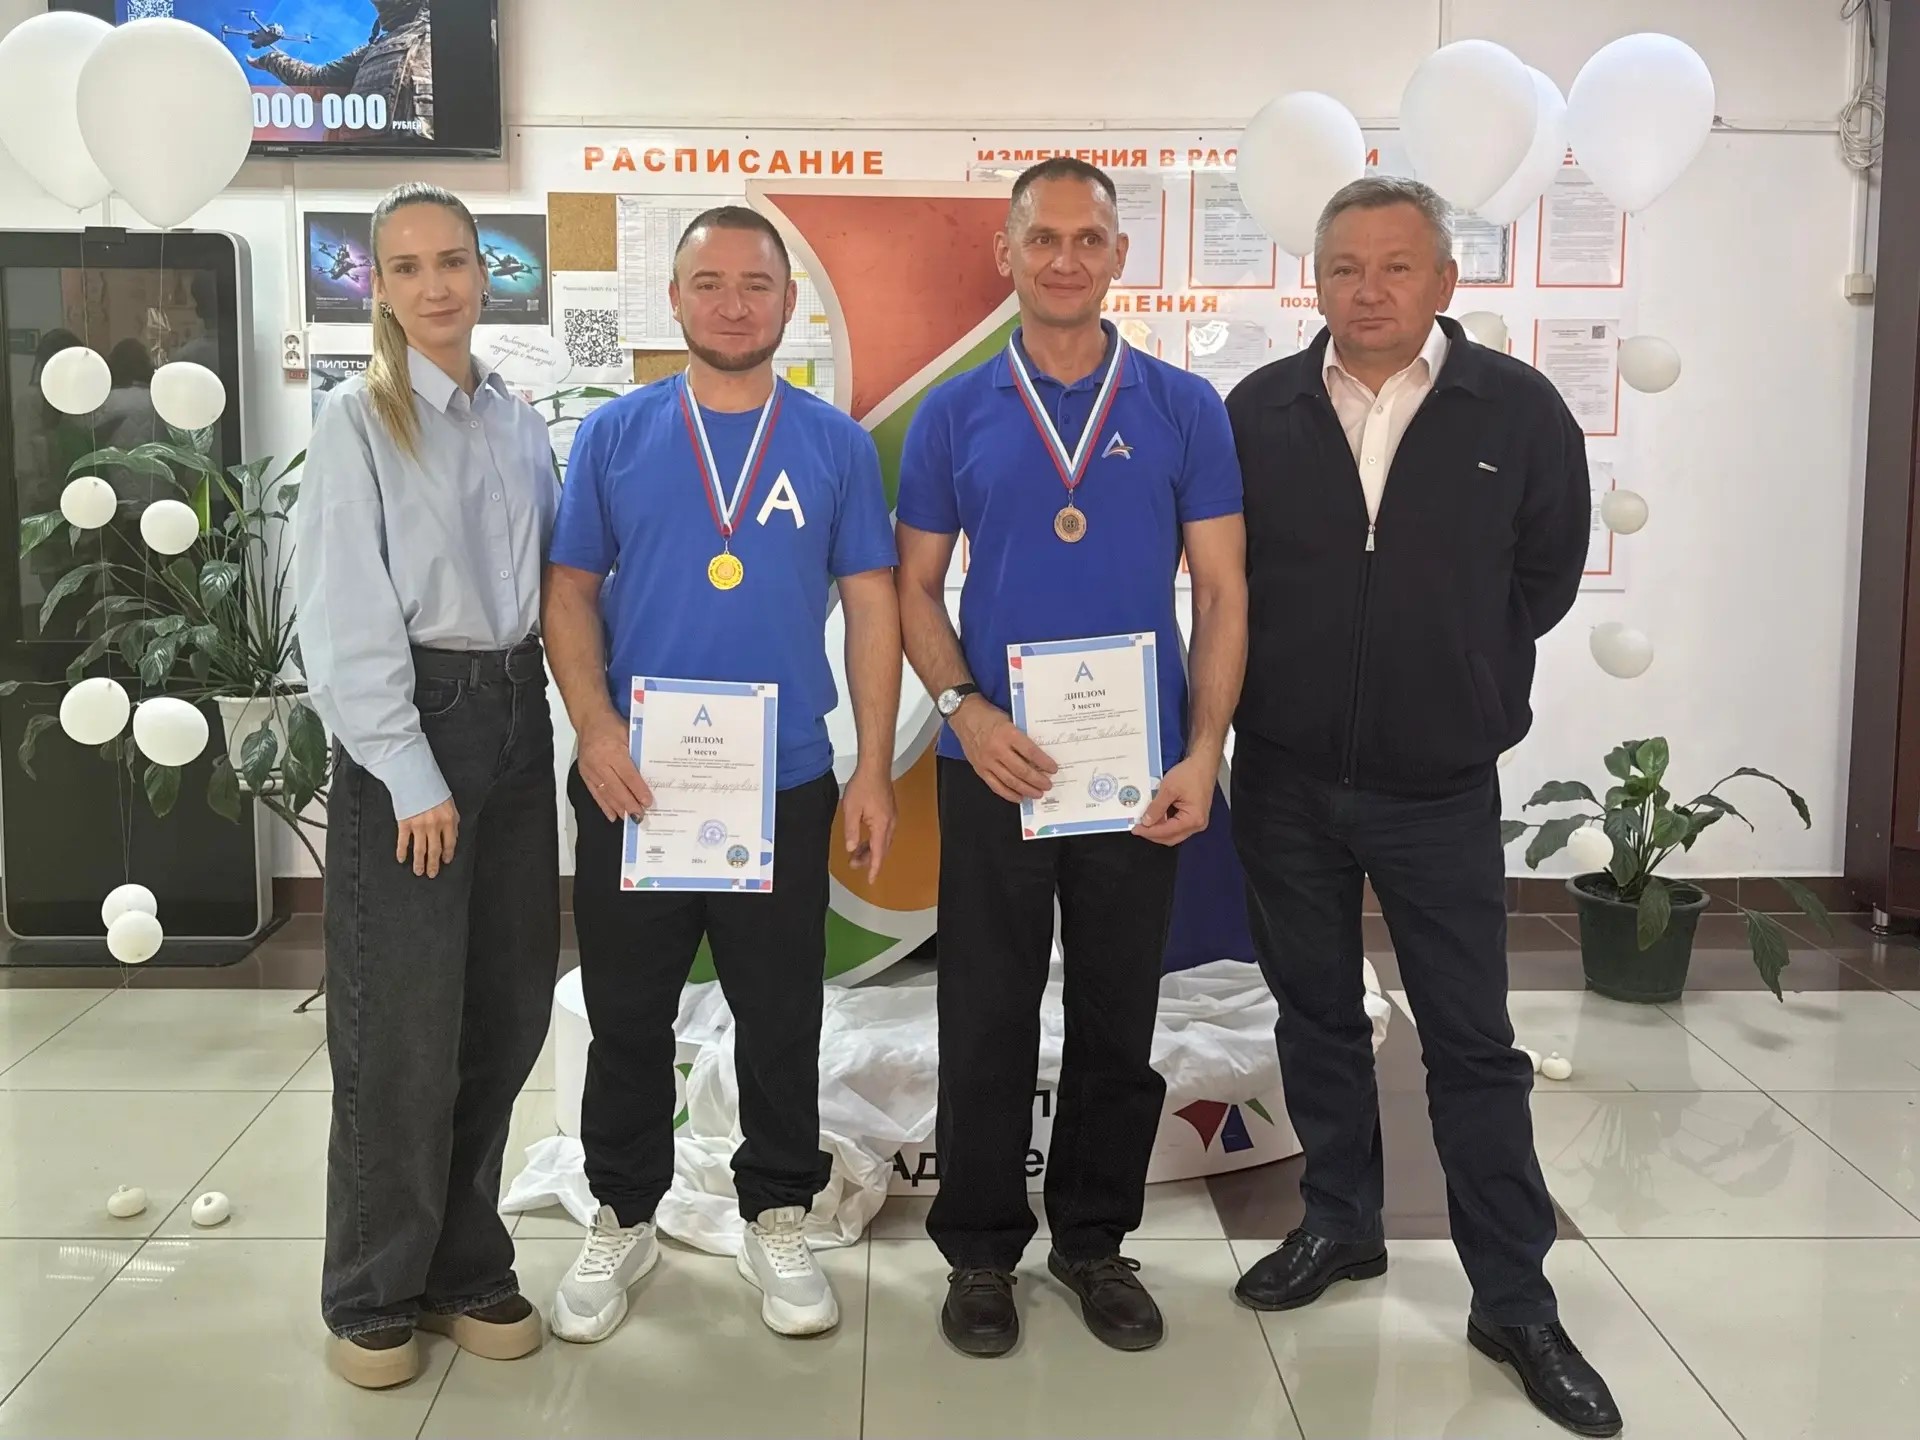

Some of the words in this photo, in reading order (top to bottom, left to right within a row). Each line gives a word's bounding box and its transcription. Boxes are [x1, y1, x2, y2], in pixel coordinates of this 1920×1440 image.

[322, 93, 387, 130] 000
[584, 147, 884, 175] РАСПИСАНИЕ
[1160, 149, 1176, 167] В
[316, 360, 367, 369] ПИЛОТЫ
[1064, 689, 1106, 701] ДИПЛОМ
[1071, 703, 1076, 711] 3
[1077, 702, 1101, 710] место
[680, 736, 724, 744] ДИПЛОМ
